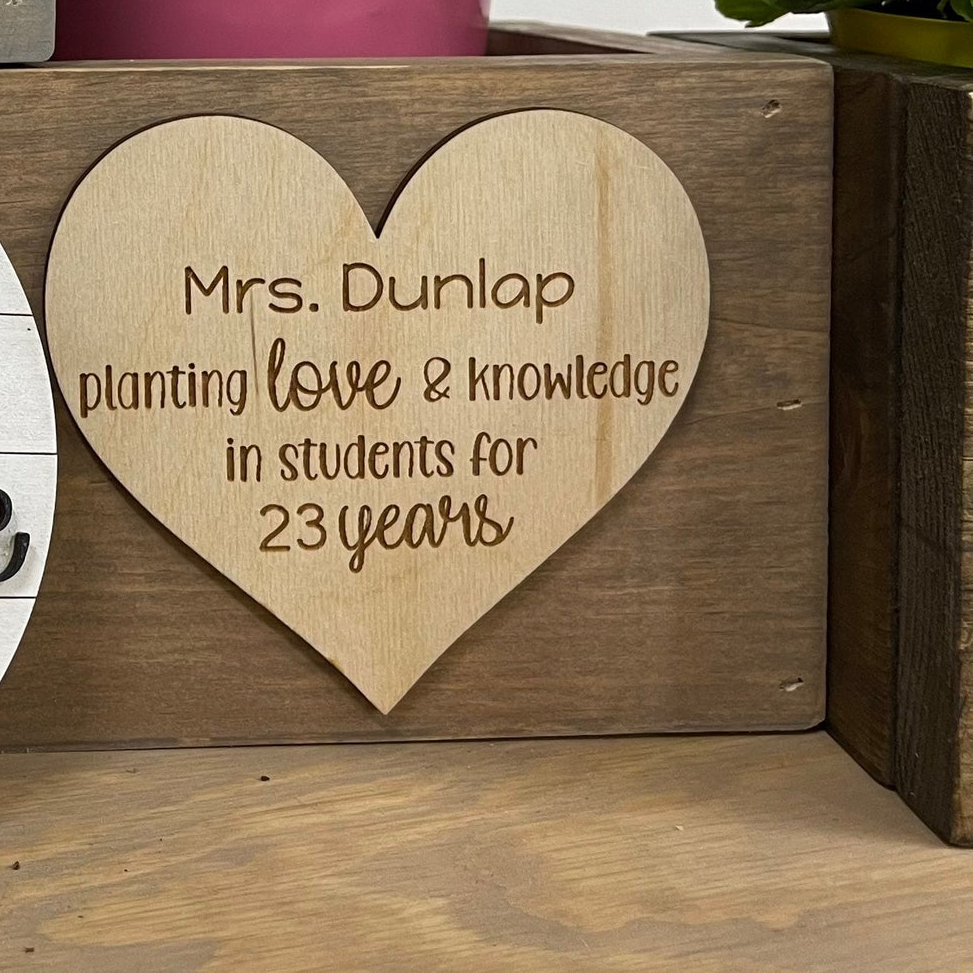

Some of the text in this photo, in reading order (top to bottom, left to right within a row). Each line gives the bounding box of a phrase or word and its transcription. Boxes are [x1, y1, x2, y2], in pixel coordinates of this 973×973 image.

[184, 258, 575, 324] Mrs. Dunlap
[79, 338, 680, 418] planting love & knowledge
[226, 431, 538, 482] in students for
[259, 494, 515, 573] 23 years
